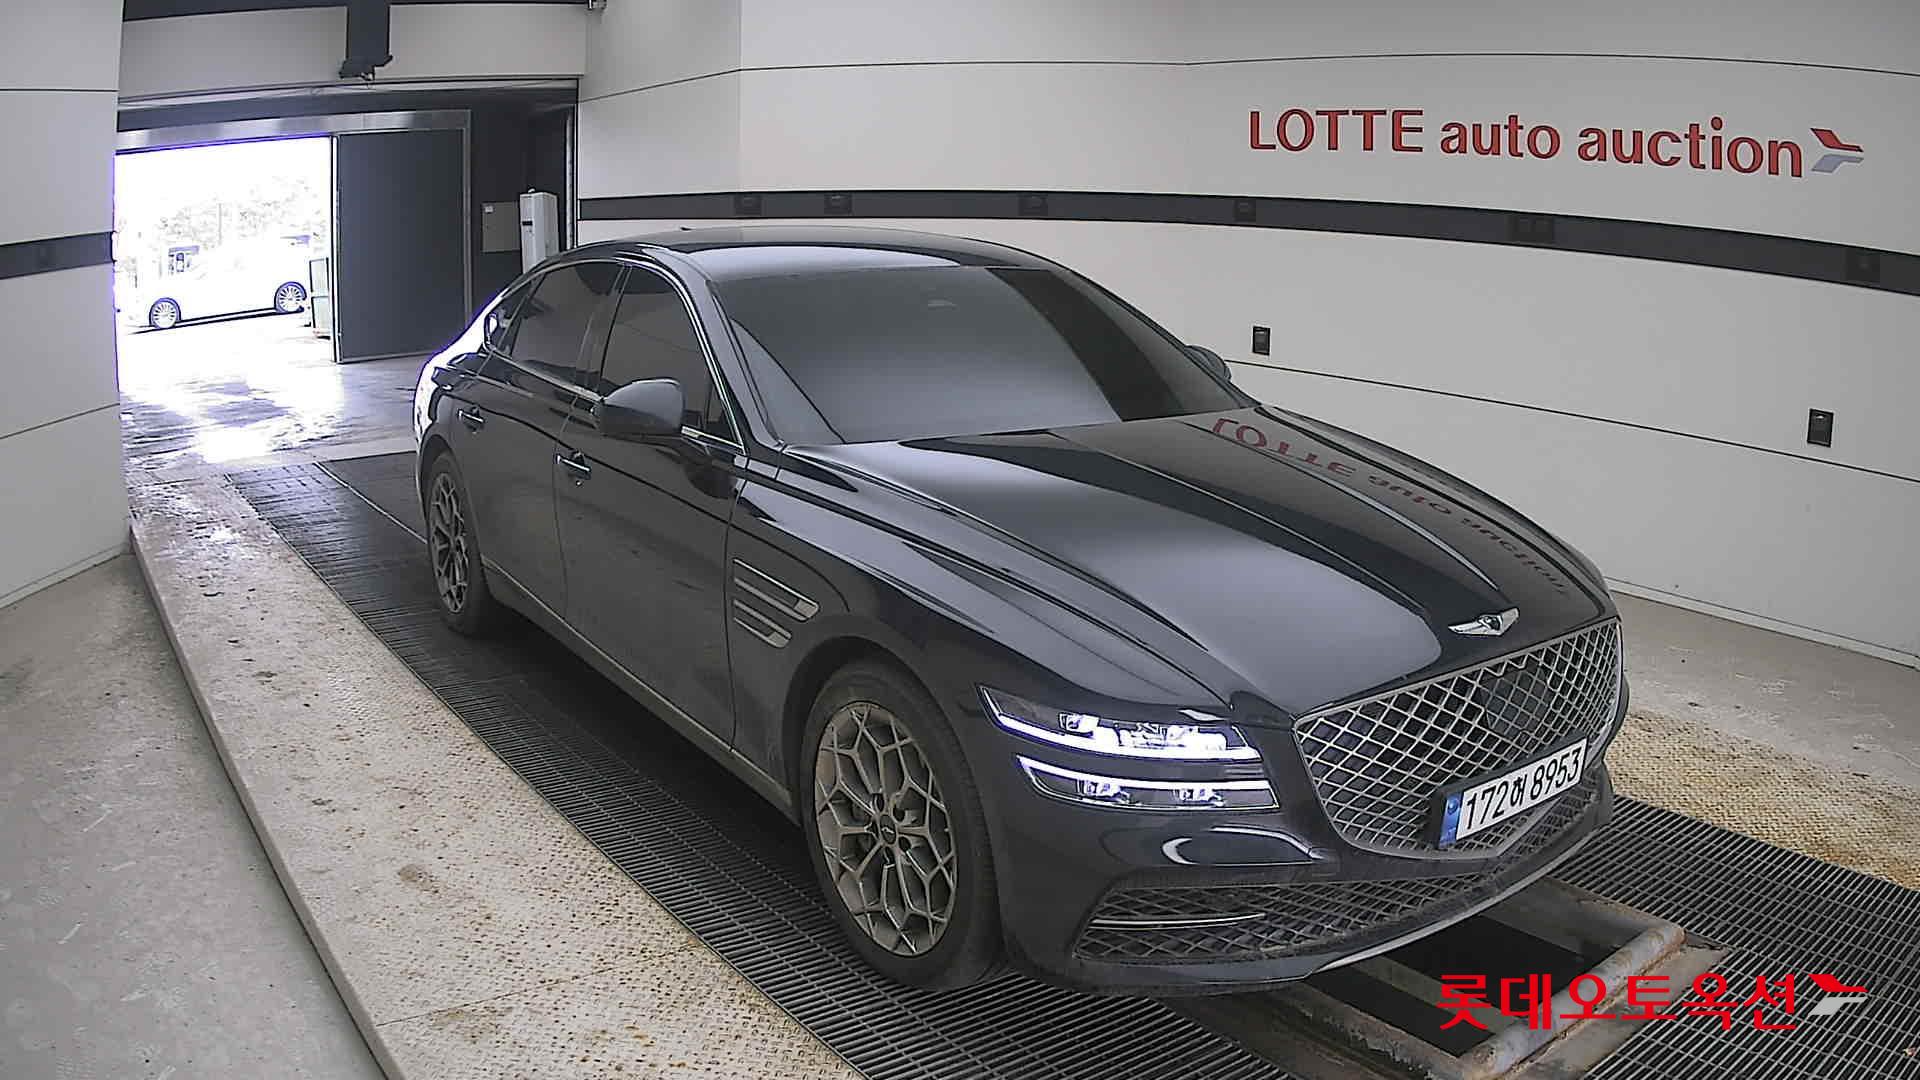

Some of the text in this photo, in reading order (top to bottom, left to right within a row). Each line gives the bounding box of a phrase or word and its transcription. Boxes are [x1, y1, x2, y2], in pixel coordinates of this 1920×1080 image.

[1249, 109, 1803, 177] LOTTE auto auction
[1466, 746, 1582, 831] 172허 8953
